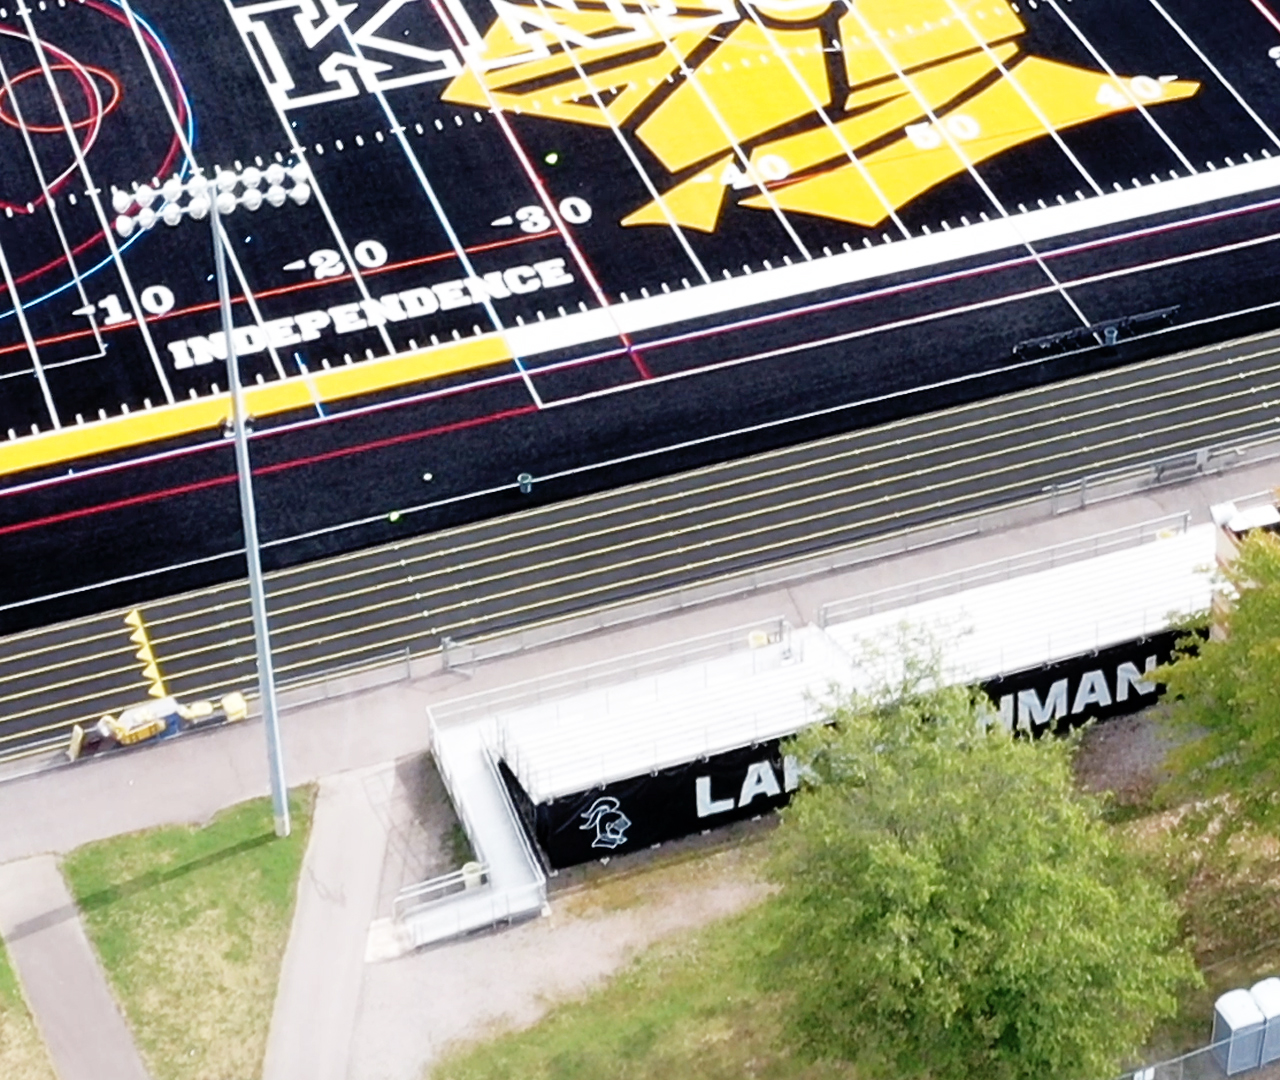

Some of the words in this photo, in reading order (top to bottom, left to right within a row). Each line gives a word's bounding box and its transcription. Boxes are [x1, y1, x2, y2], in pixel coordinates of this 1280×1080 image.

[1094, 74, 1163, 109] 40
[903, 115, 981, 151] 50
[515, 196, 592, 234] 30
[307, 239, 389, 281] 20
[98, 284, 176, 326] 10
[167, 257, 574, 370] INDEPENDENCE
